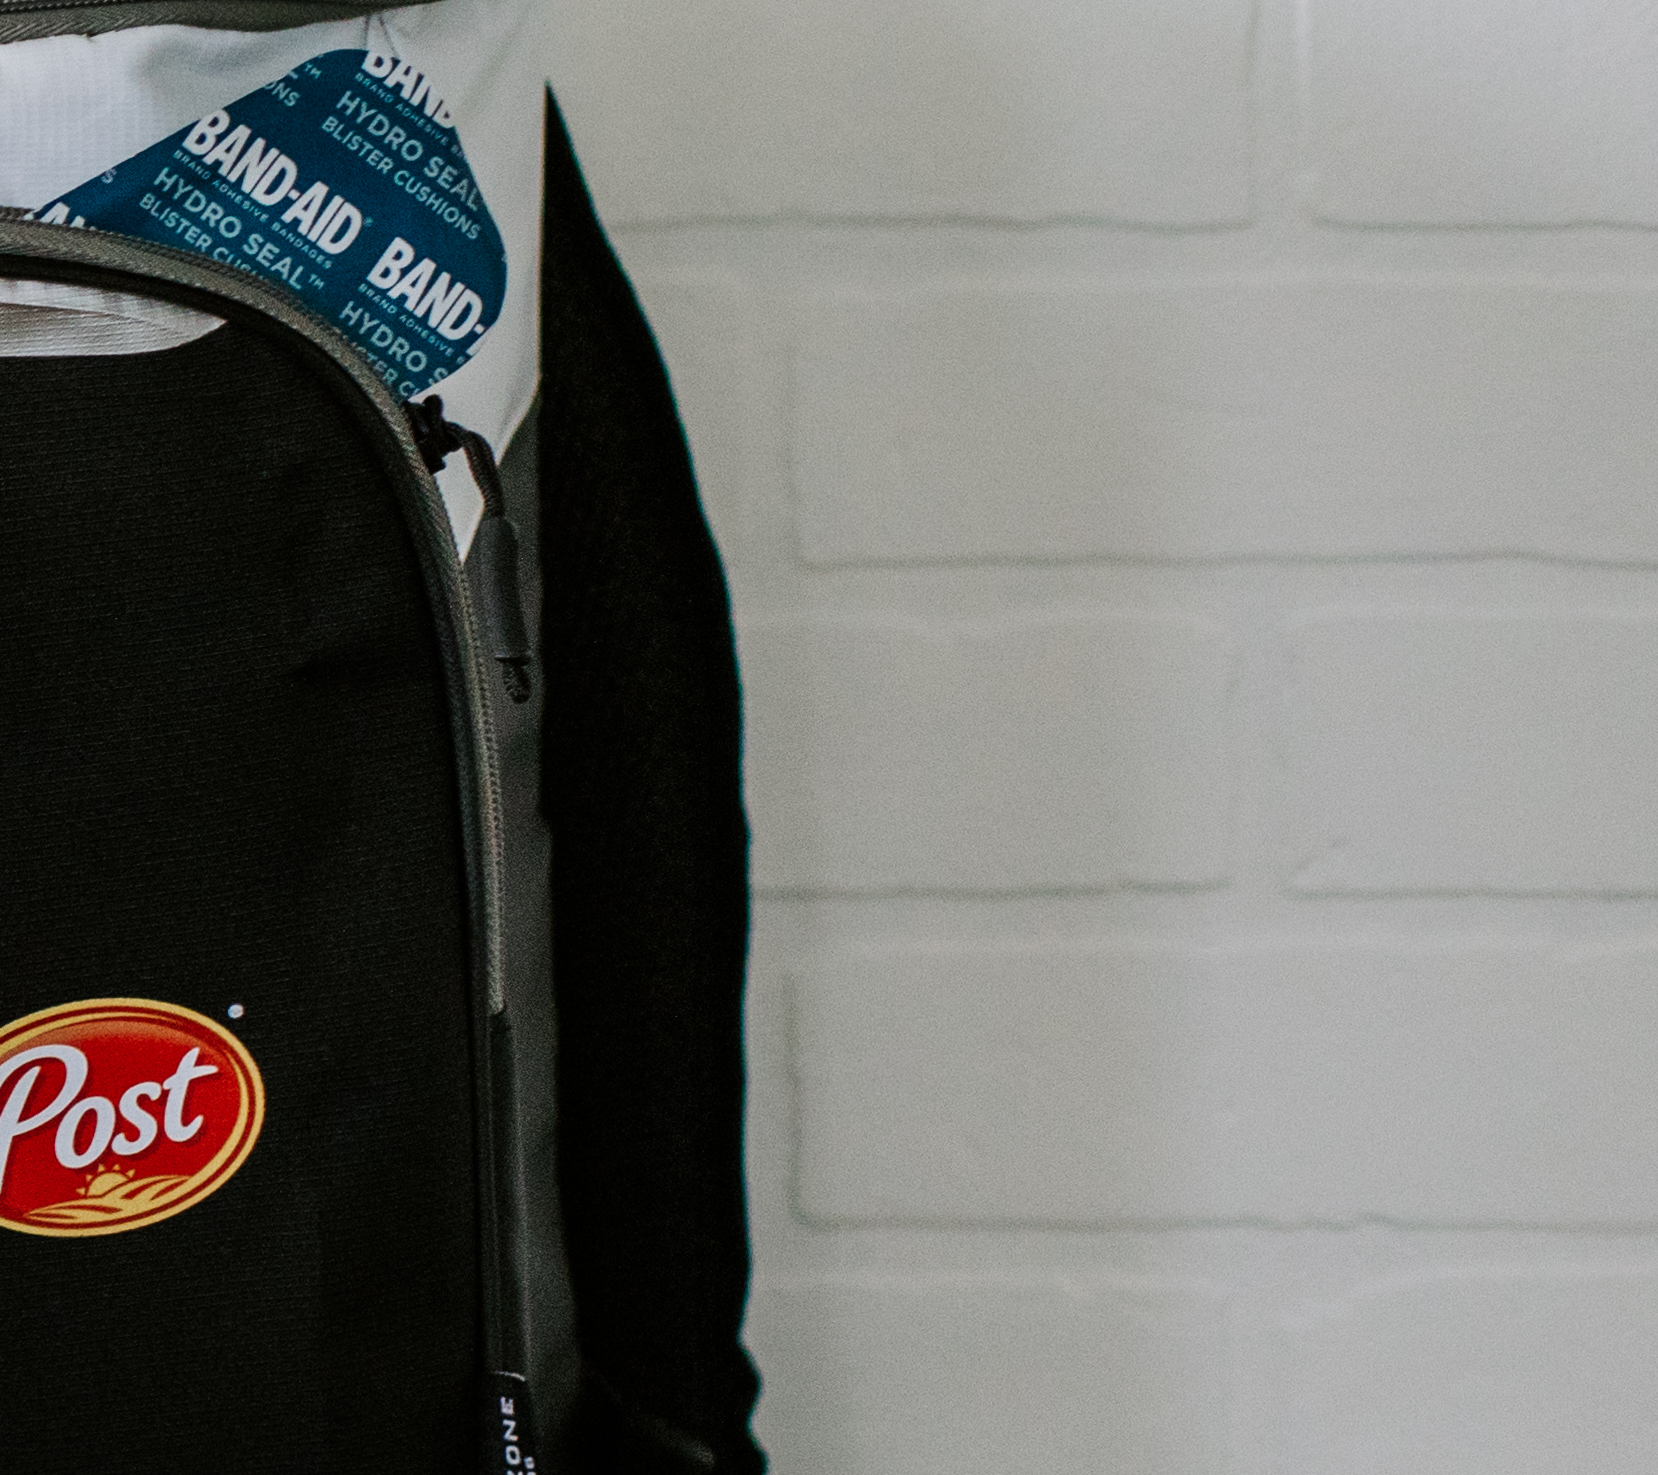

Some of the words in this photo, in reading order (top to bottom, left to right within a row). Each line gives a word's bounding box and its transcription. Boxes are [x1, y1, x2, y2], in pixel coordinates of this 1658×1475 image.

[336, 90, 423, 162] HYDRO
[153, 166, 242, 238] HYDRO
[173, 148, 212, 180] BRAND
[271, 222, 333, 270] BANDAGES
[322, 115, 394, 175] BLISTER
[393, 170, 481, 240] CUSHIONS
[139, 192, 212, 252] BLISTER
[339, 300, 428, 373] HYDRO
